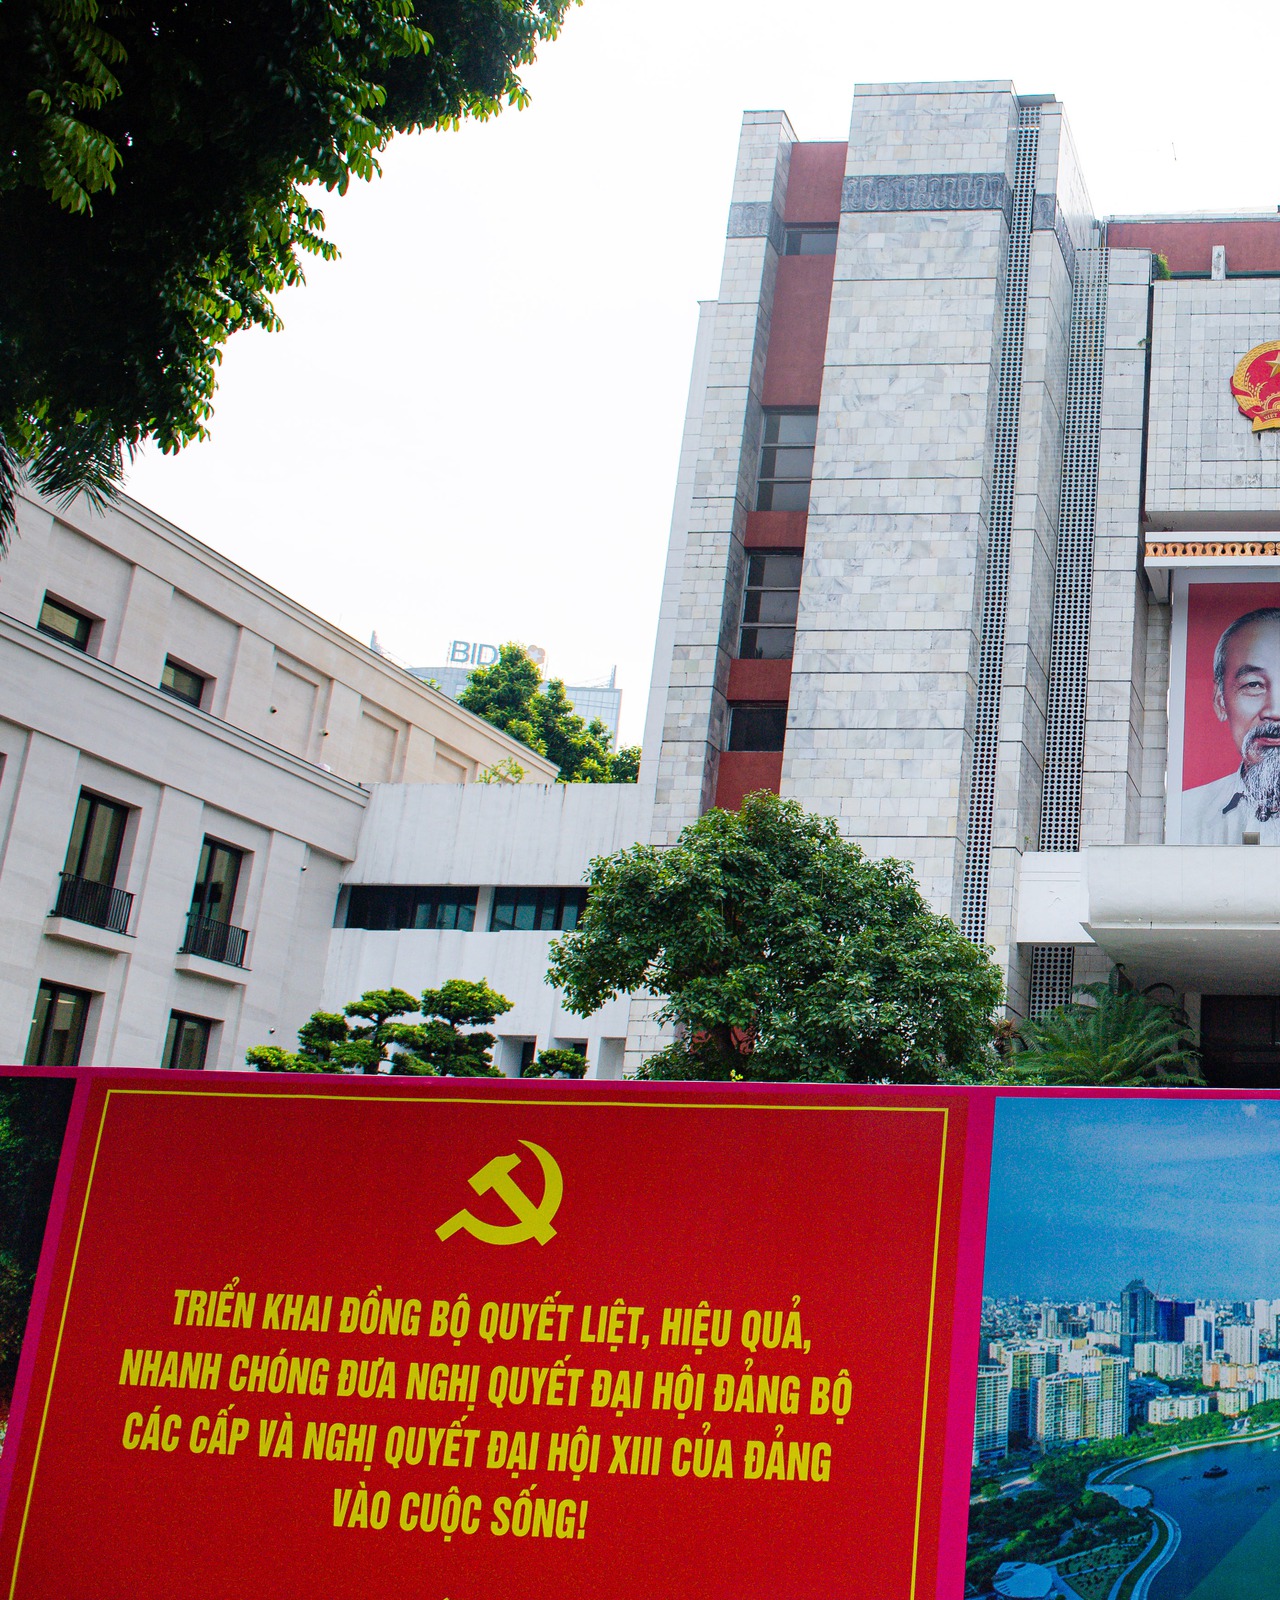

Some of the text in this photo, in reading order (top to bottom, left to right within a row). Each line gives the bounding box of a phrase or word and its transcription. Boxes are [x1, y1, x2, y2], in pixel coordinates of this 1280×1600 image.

[450, 640, 499, 665] BID
[173, 1276, 811, 1355] TRIỂN KHAI ĐỒNG BỘ QUYẾT LIỆT, HIỆU QUẢ,
[119, 1348, 853, 1425] NHANH CHÓNG ĐƯA NGHỊ QUYẾT ĐẠI HỘI ĐẢNG BỘ
[122, 1403, 832, 1482] CÁC CẤP VÀ NGHỊ QUYẾT ĐẠI HỘI XIII CỦA ĐẢNG
[333, 1481, 589, 1542] VÀO CUỘC SỐNG!
